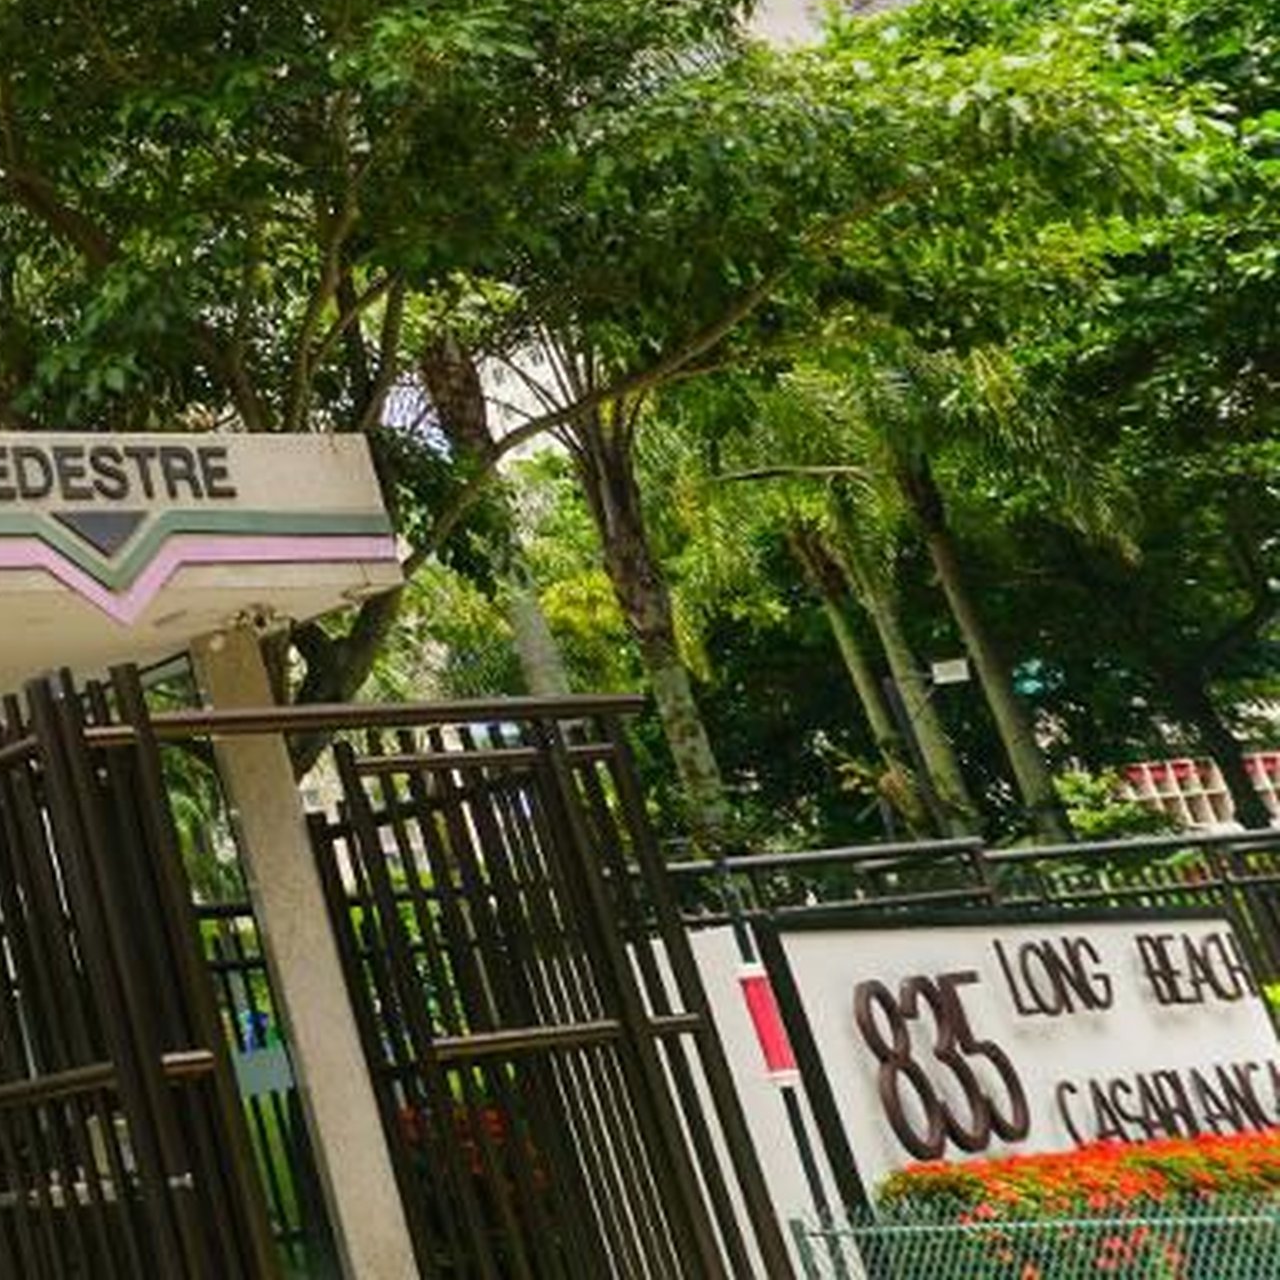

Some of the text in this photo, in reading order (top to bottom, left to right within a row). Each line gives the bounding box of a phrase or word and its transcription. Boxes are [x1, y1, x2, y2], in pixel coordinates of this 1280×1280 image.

[992, 931, 1259, 1016] LONG BEACH
[853, 970, 1031, 1160] 835
